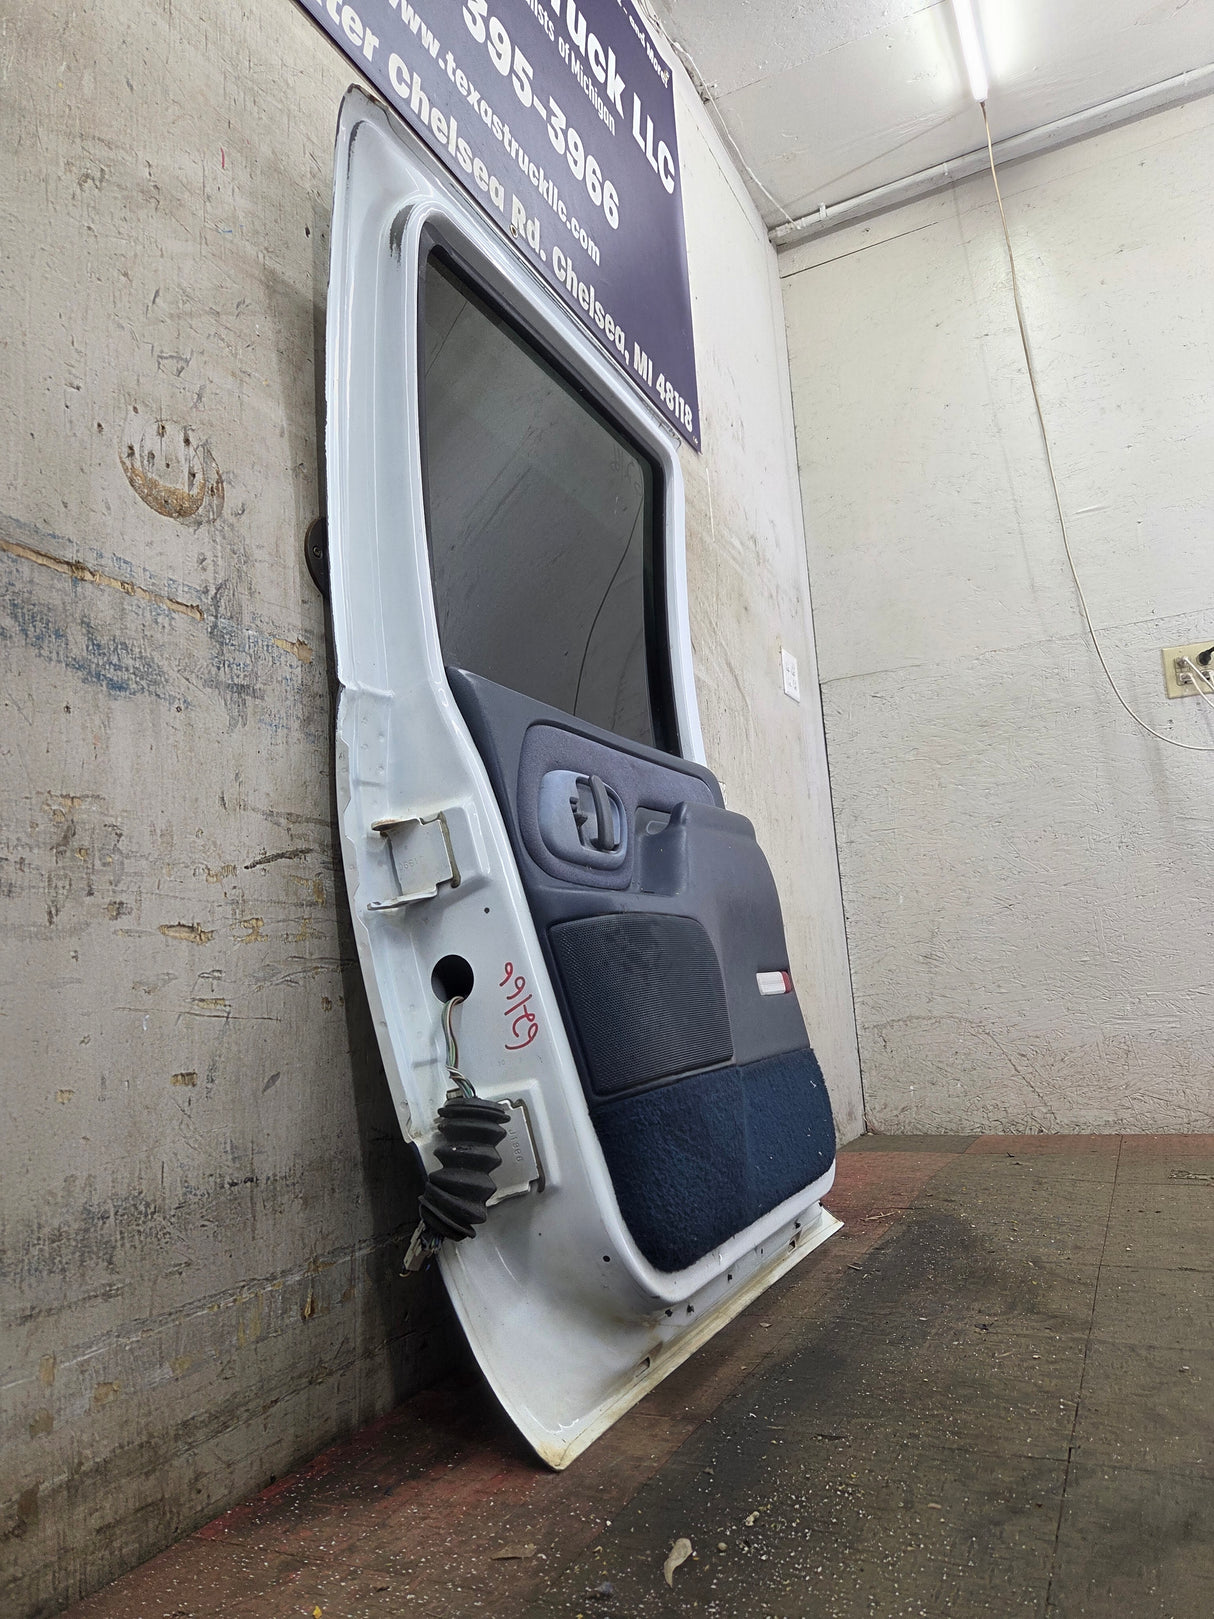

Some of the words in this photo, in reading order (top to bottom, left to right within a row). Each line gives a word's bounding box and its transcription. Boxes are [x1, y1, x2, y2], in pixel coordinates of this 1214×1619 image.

[388, 0, 600, 266] ww.texastruckllc.com
[558, 36, 570, 65] of
[571, 50, 616, 137] Michigan
[632, 92, 675, 194] LLC
[388, 53, 505, 213] Chelsea
[511, 194, 547, 262] Rd.
[552, 246, 630, 366] Chelsea,
[633, 341, 653, 387] MI
[656, 373, 693, 432] 48118
